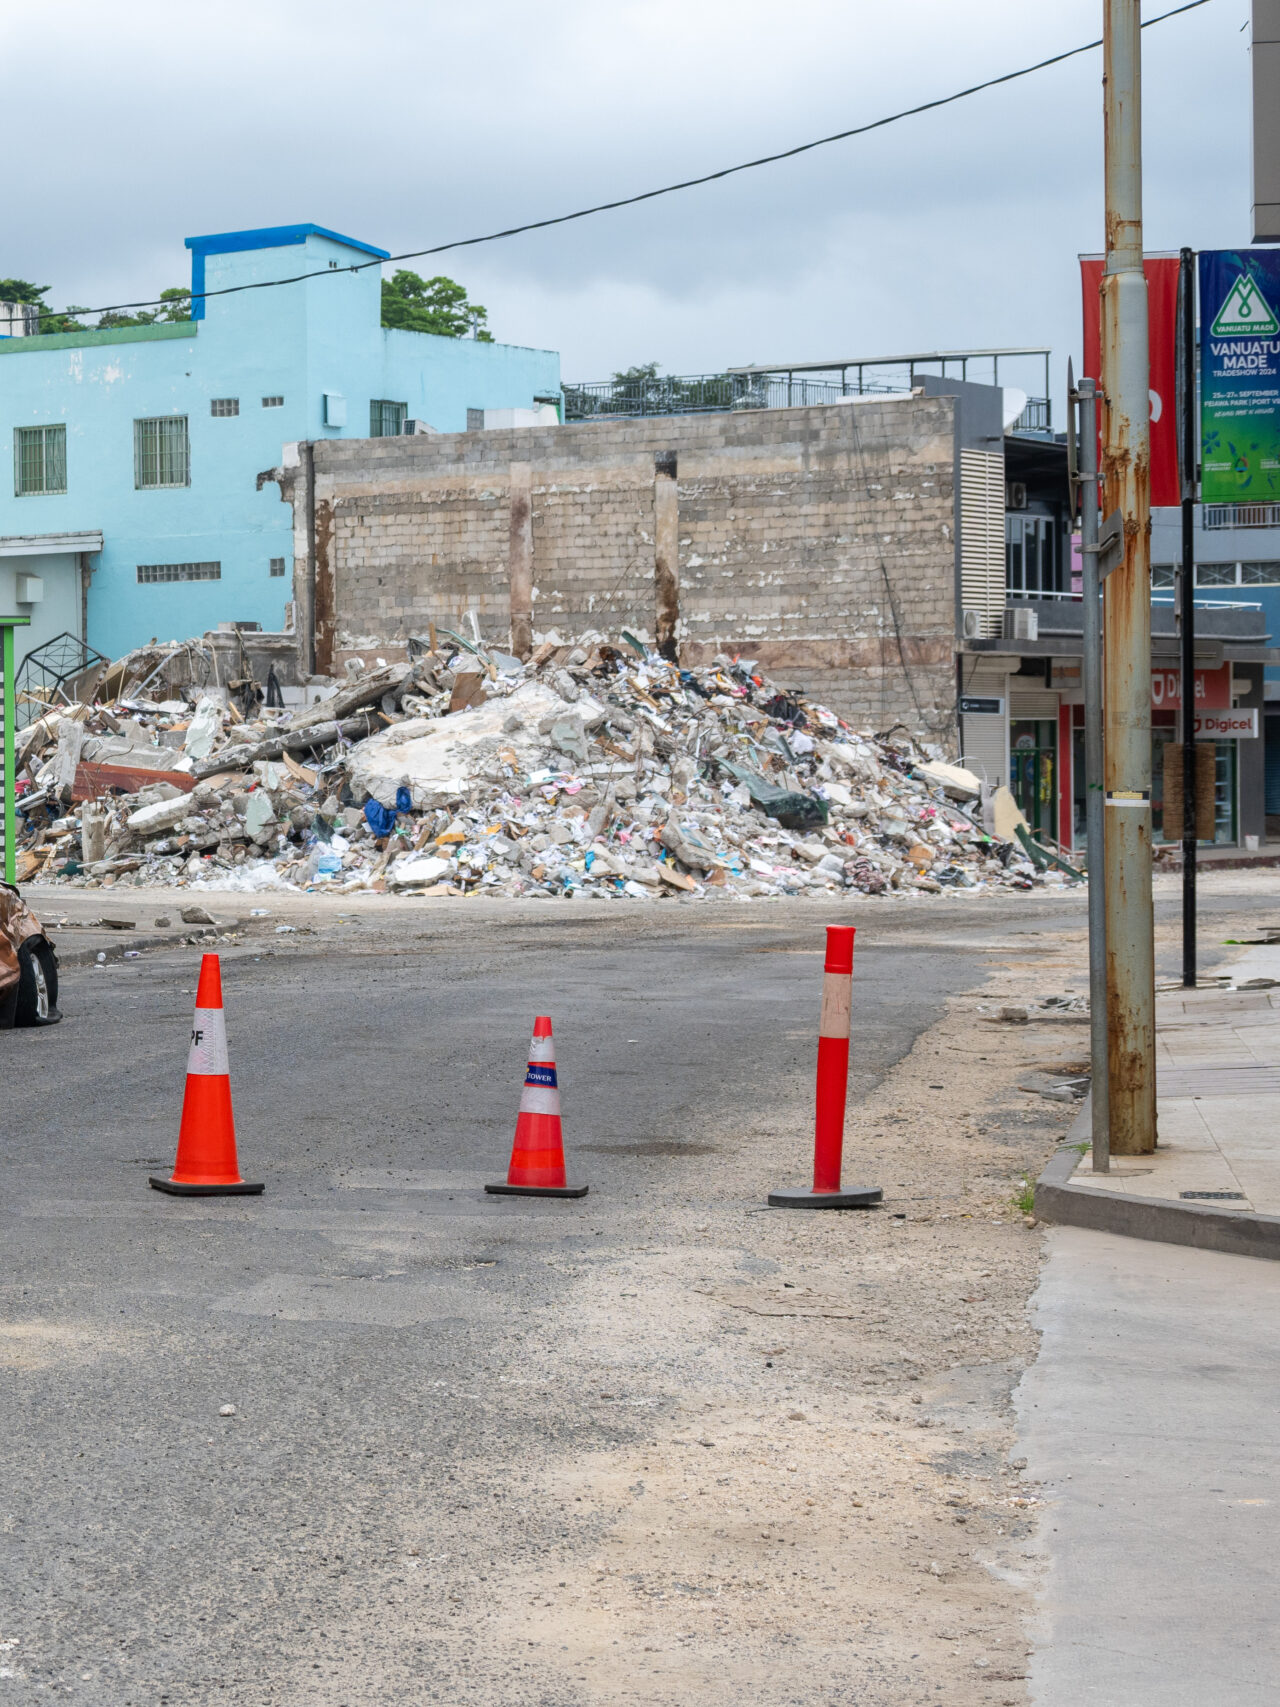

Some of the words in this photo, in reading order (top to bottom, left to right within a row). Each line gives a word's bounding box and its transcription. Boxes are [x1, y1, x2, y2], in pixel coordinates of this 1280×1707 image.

[1216, 325, 1251, 333] VANUATU
[1253, 324, 1274, 332] MADE
[1210, 341, 1280, 356] VANUATU
[1223, 355, 1268, 370] MADE
[1212, 369, 1258, 377] TRADESHOW
[1259, 368, 1277, 376] 2024
[1239, 389, 1279, 398] SEPTEMBER
[1205, 717, 1252, 733] Digicel
[527, 1072, 552, 1082] TOWER
